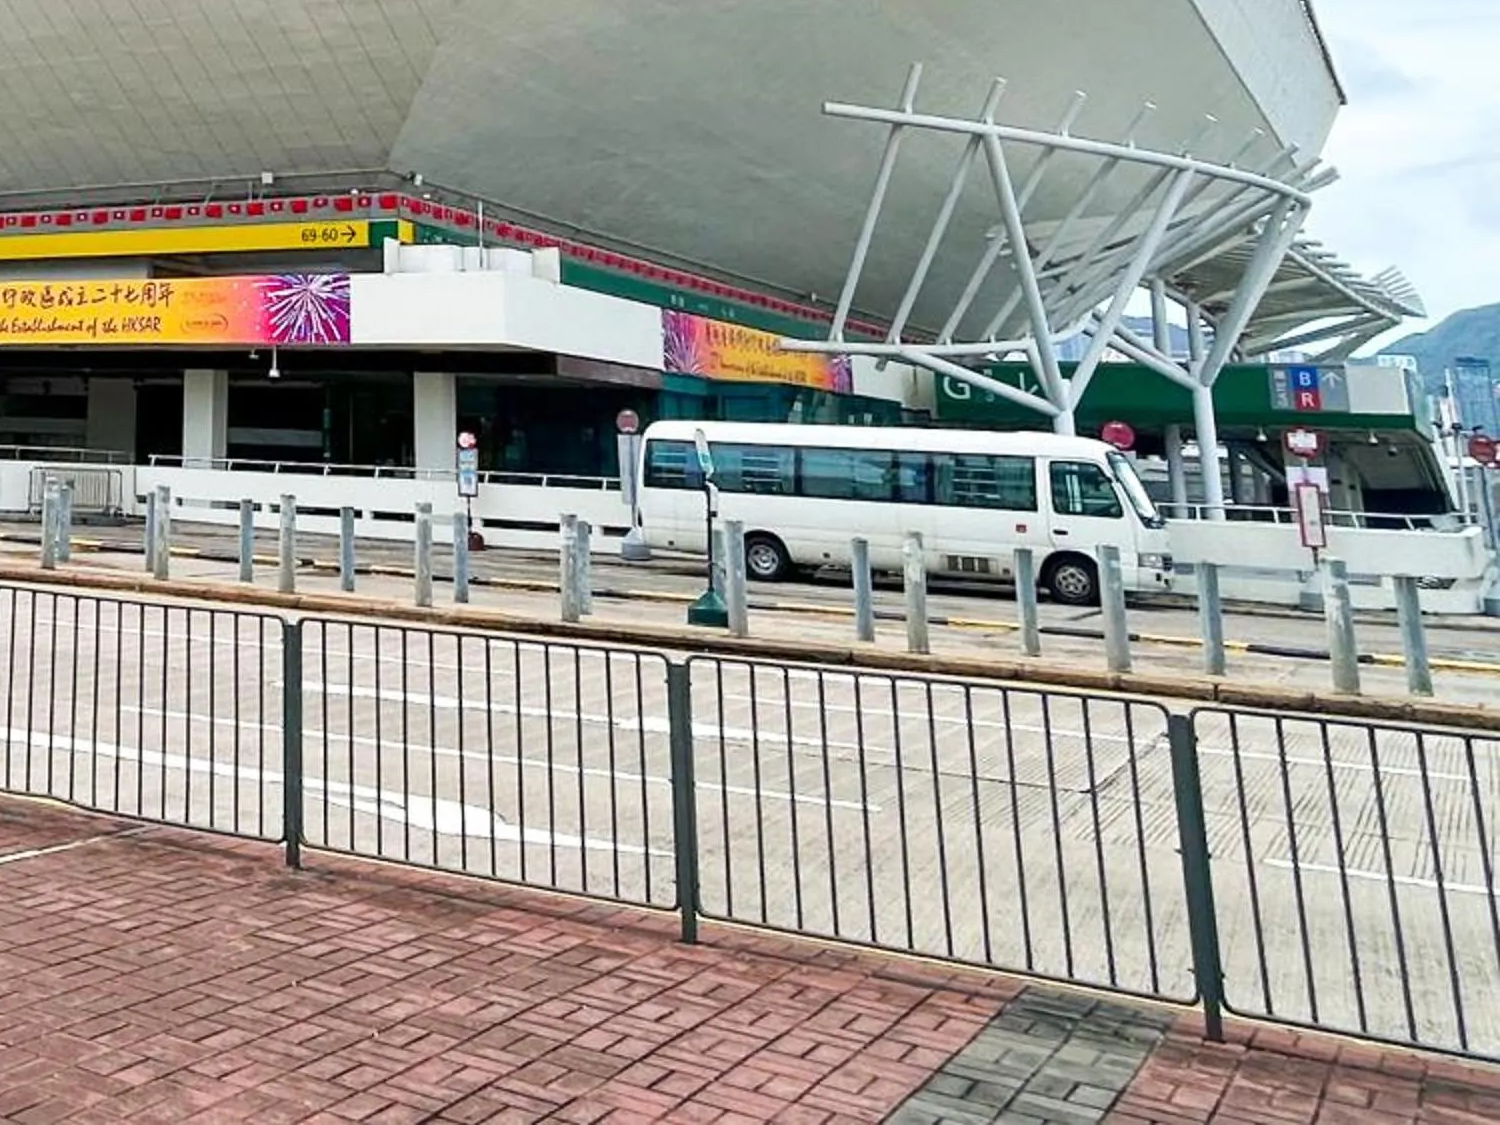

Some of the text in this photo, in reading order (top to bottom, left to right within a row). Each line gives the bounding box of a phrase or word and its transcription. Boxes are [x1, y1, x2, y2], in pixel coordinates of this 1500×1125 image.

[121, 315, 161, 333] HKSAR
[1299, 371, 1312, 386] B
[943, 376, 971, 400] G
[1301, 392, 1315, 407] R
